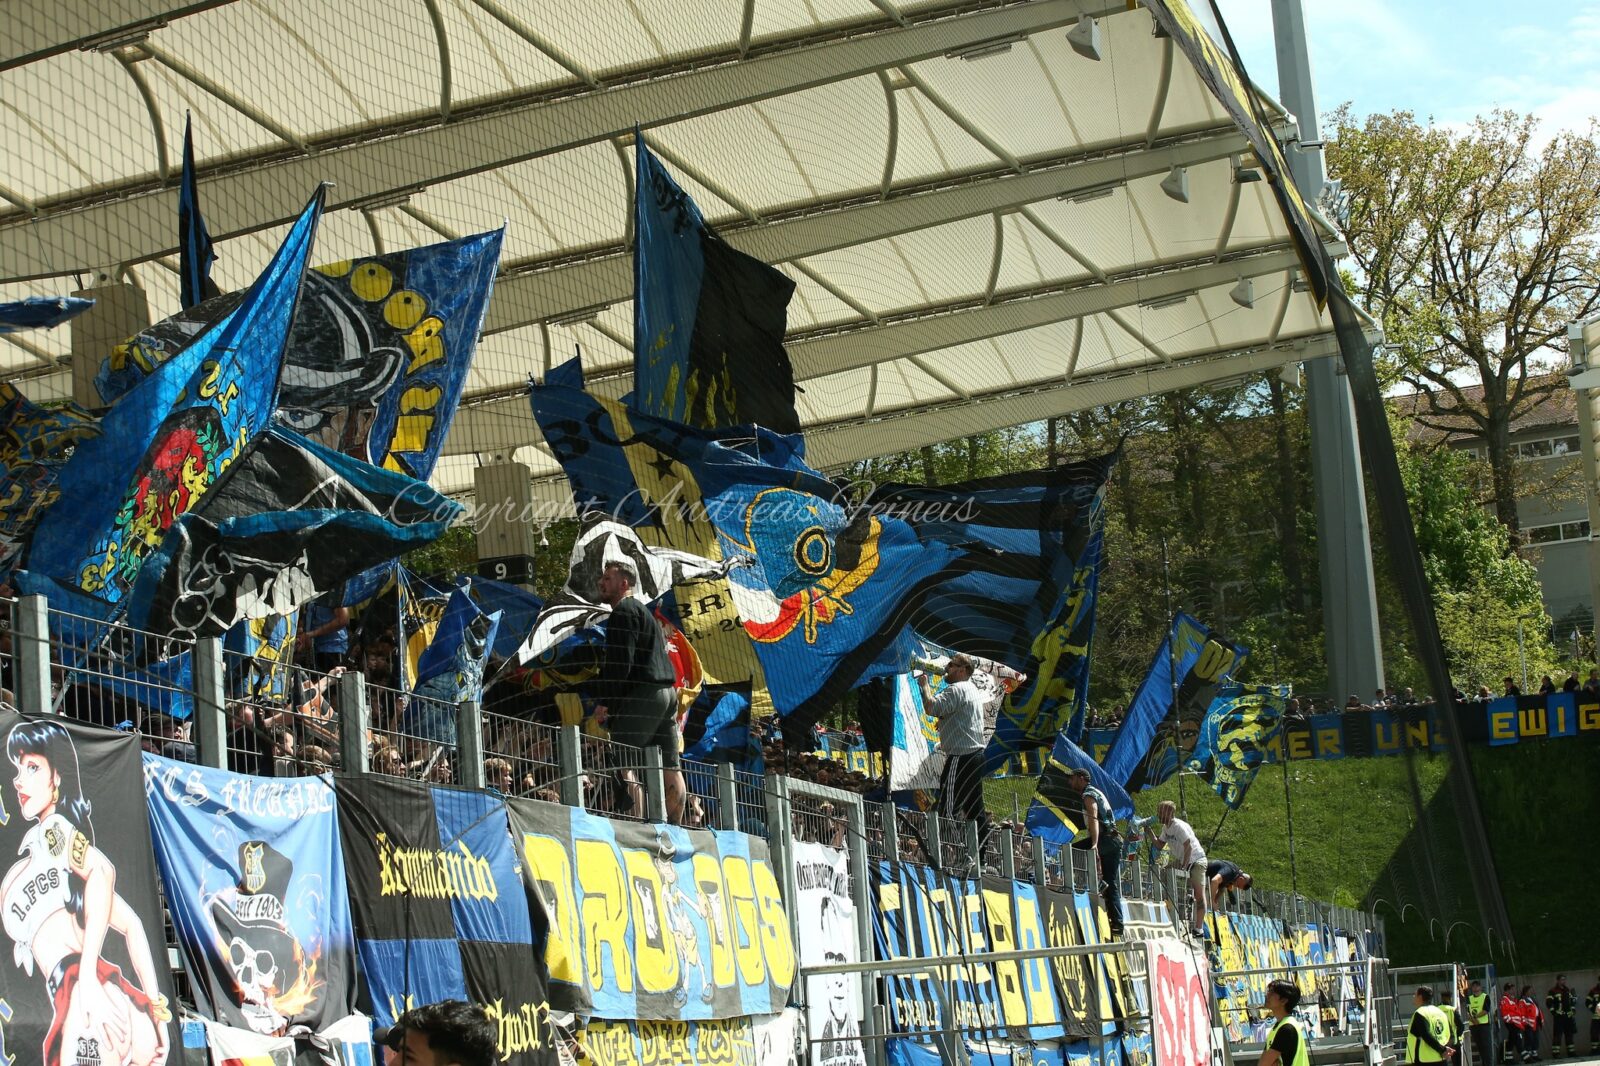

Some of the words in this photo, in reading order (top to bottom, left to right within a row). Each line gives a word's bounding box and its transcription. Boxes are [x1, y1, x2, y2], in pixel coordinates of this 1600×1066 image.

[495, 563, 507, 580] 9
[527, 562, 534, 579] 9
[376, 832, 498, 903] Kommando
[11, 867, 60, 922] 1.FCS
[255, 896, 283, 920] 1903
[523, 833, 797, 994] DROOGS
[955, 999, 1000, 1030] ARREBRUCK
